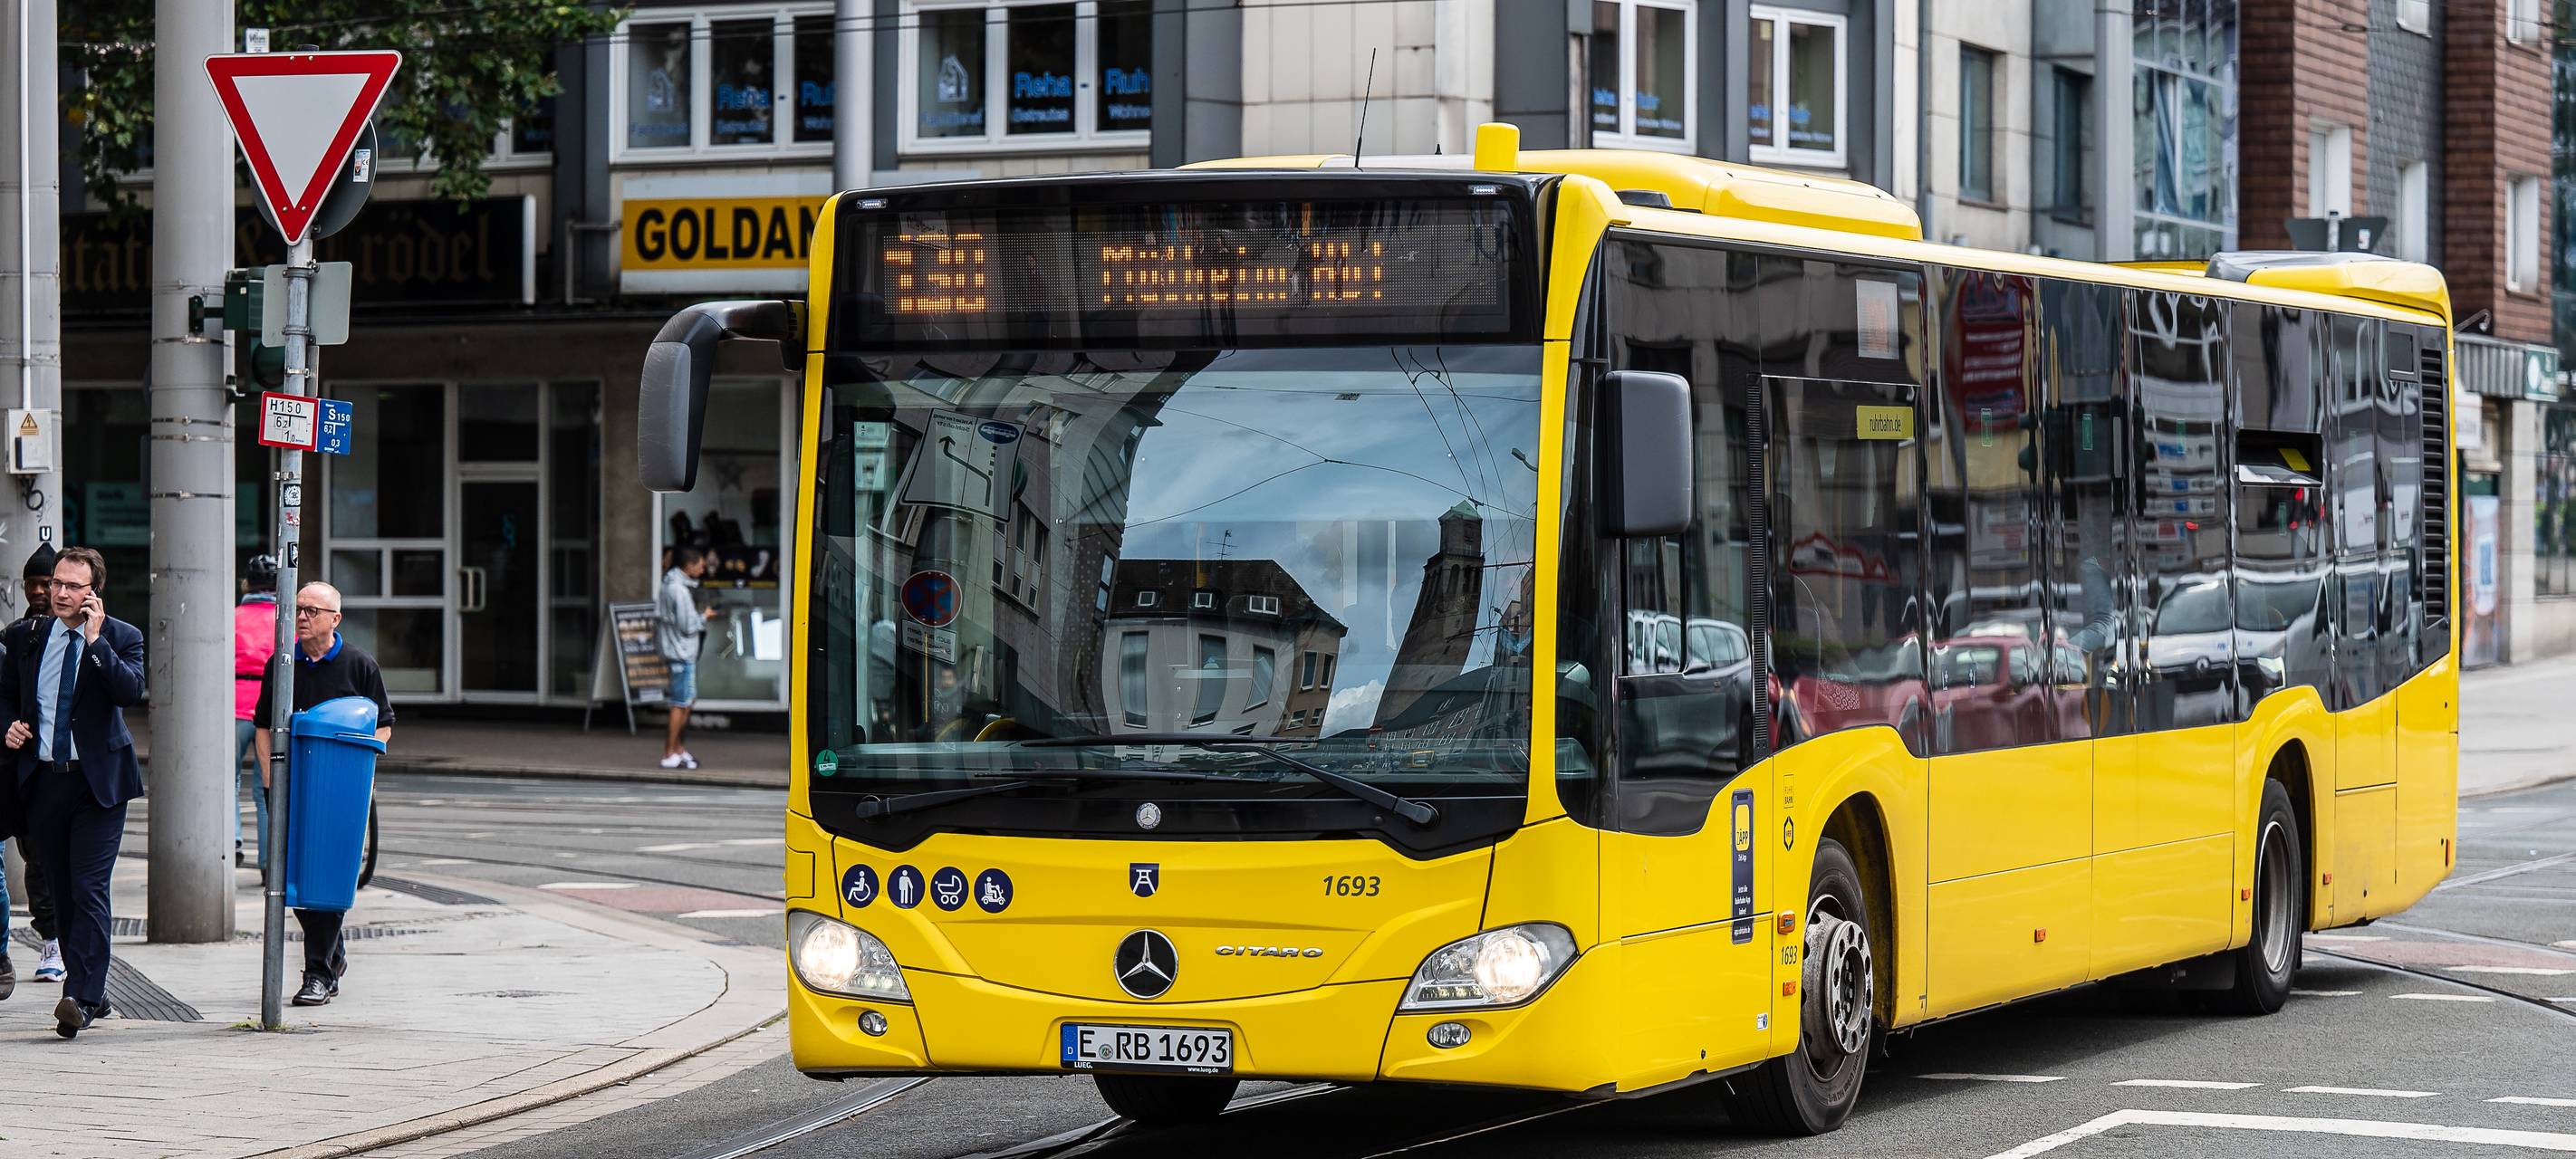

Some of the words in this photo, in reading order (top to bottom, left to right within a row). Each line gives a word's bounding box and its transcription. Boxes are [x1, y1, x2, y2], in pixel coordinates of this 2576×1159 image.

[1014, 72, 1072, 98] Reha
[1870, 413, 1901, 432] ruhrbahn.de
[1322, 876, 1380, 896] 1693
[1216, 945, 1323, 957] CITARO
[1781, 945, 1797, 965] 1693
[1080, 1030, 1096, 1058] E
[1116, 1032, 1151, 1060] RB
[1158, 1034, 1227, 1063] 1693
[1074, 1061, 1093, 1069] LUEG.
[1187, 1067, 1219, 1075] www.lueg.de
